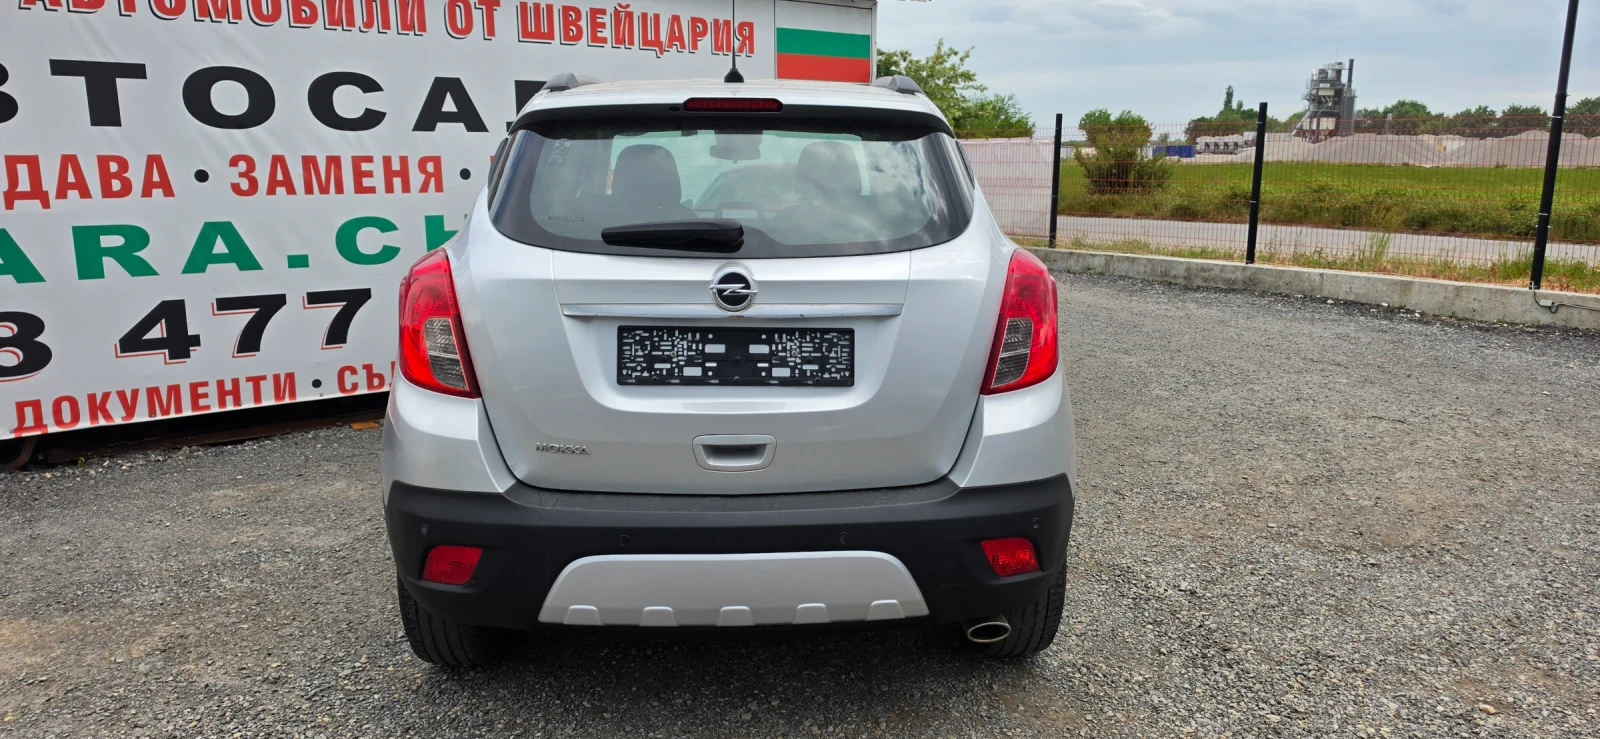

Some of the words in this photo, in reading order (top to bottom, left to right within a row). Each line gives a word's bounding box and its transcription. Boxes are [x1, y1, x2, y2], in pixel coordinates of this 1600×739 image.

[19, 0, 428, 36] МОБИЛИ
[444, 0, 501, 40] ОТ
[518, 1, 755, 58] ШВЕЙЦАРИЯ
[0, 59, 549, 132] ТОСА
[3, 153, 176, 210] ДАВА
[228, 154, 444, 197] ЗАМЕНЯ
[114, 288, 372, 365] 477
[13, 371, 298, 438] ДОКУМЕНТИ
[536, 442, 591, 455] MOKKA
